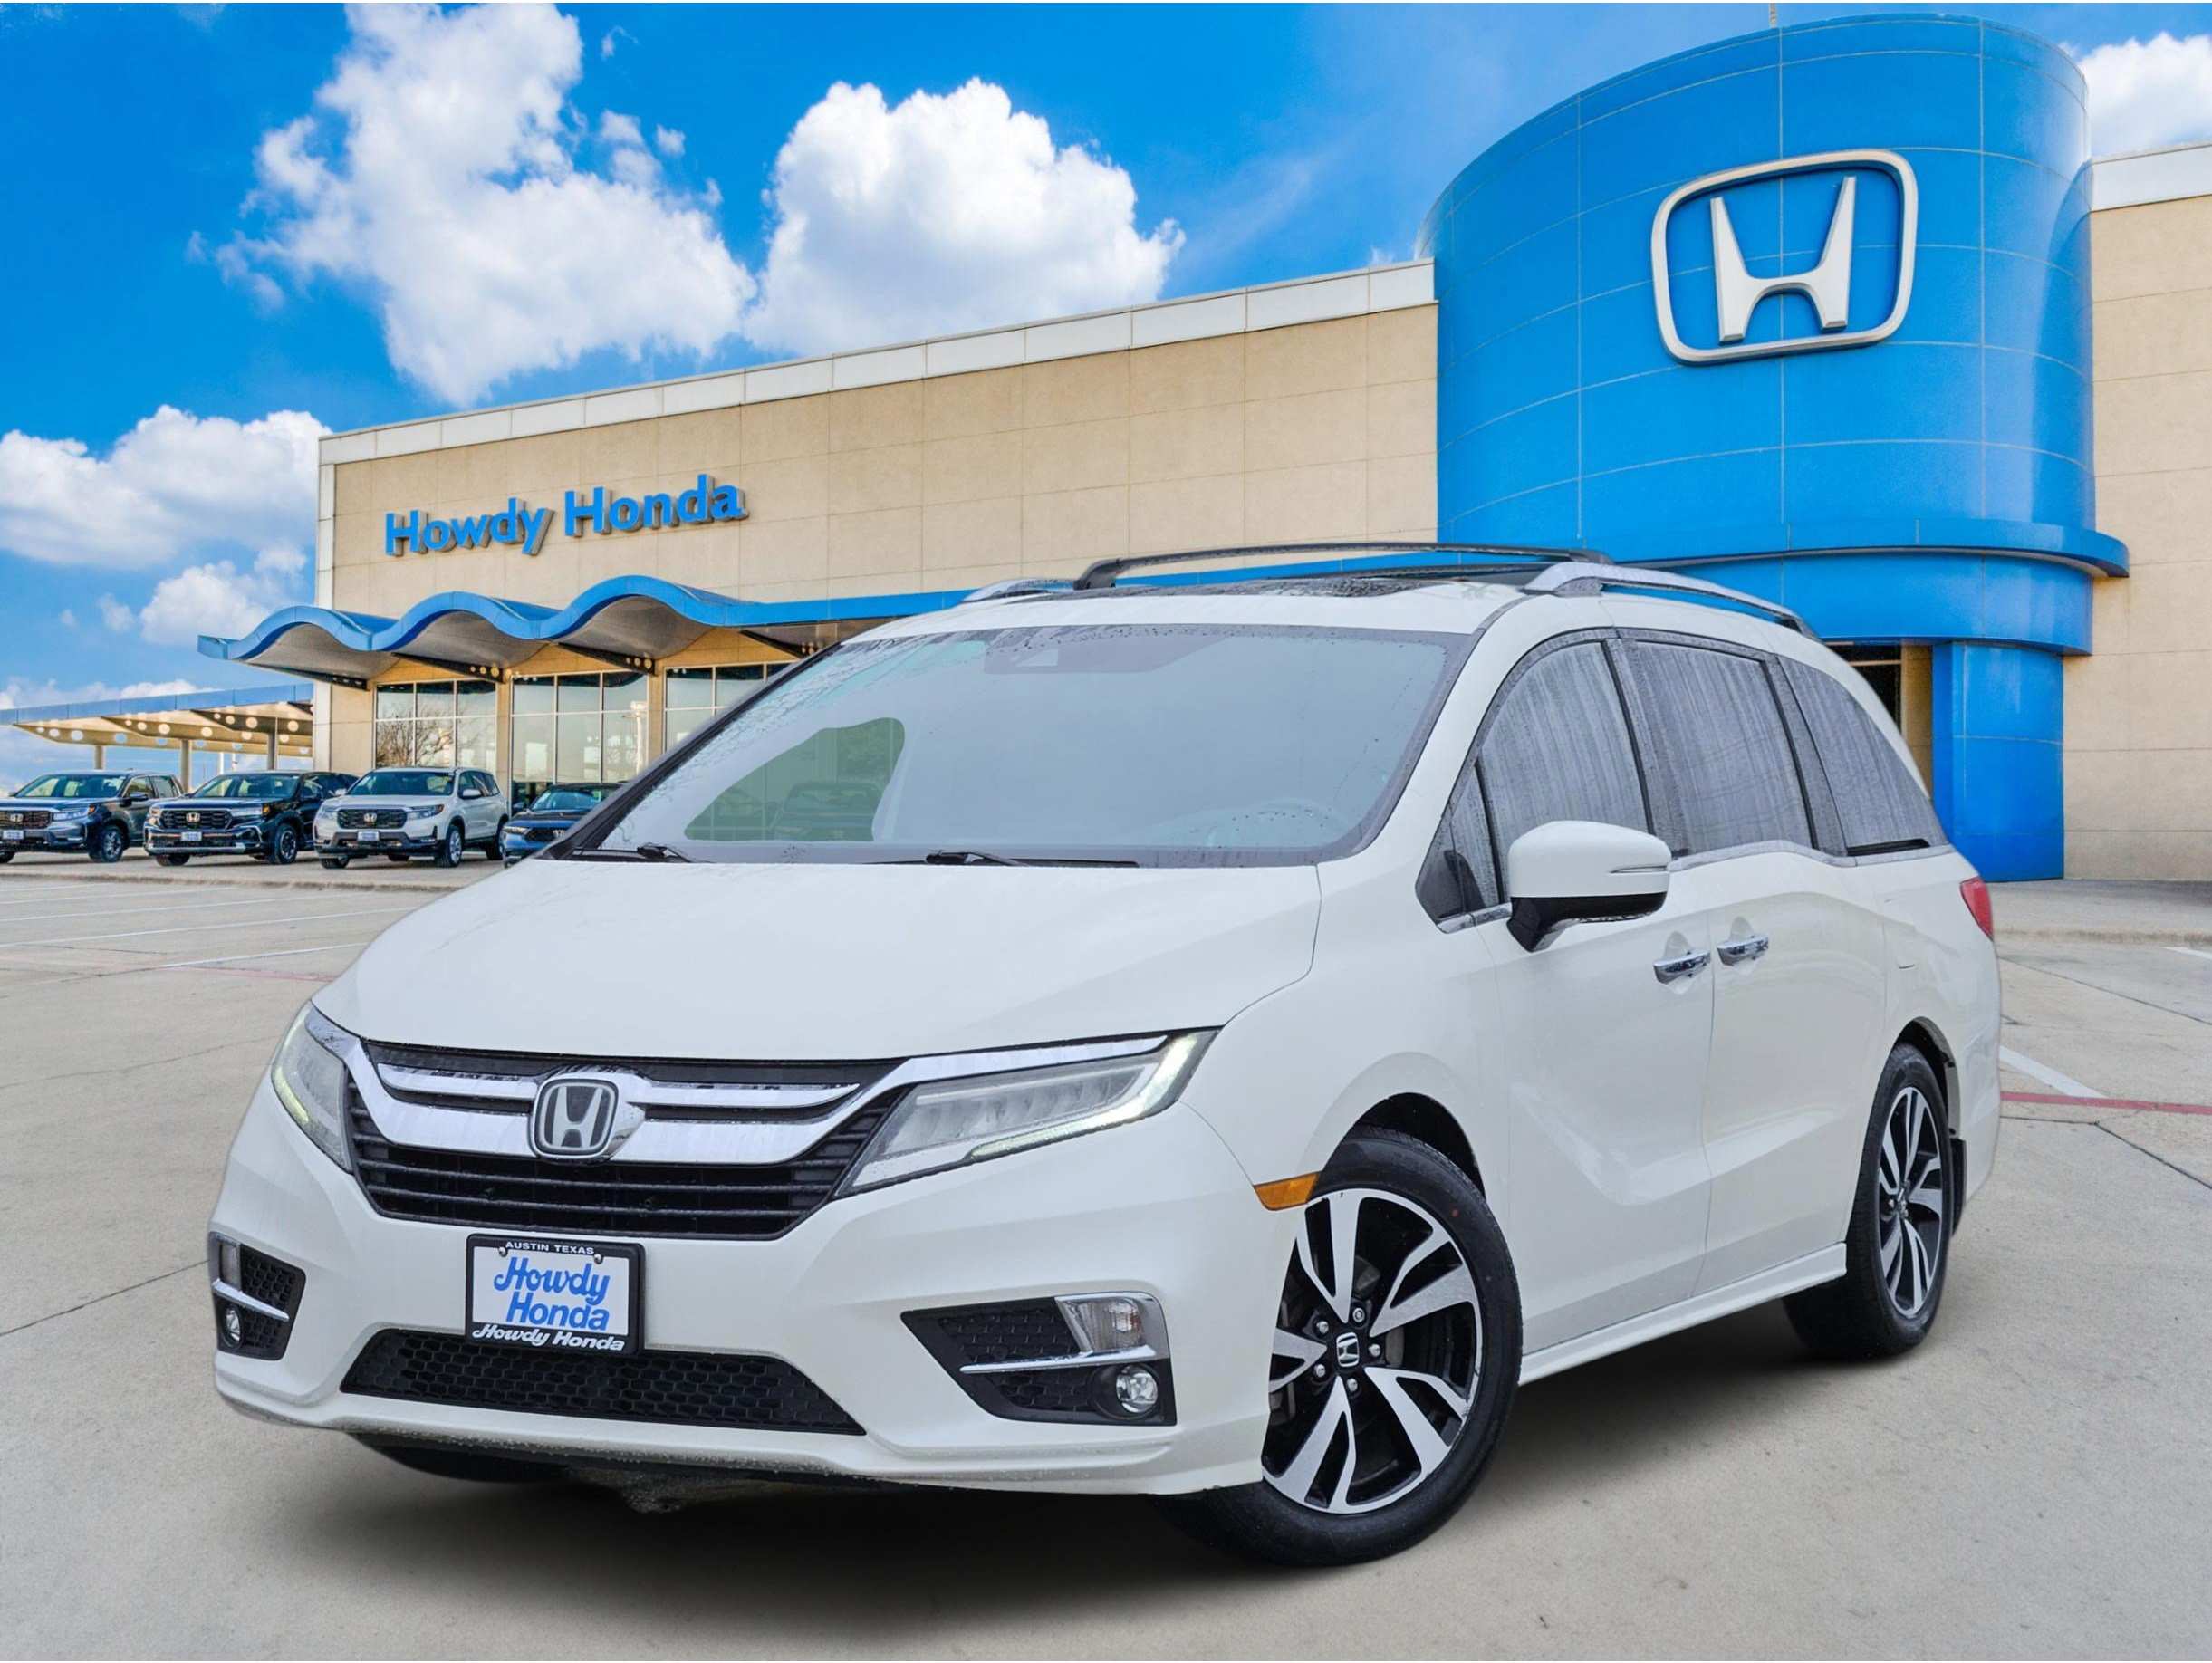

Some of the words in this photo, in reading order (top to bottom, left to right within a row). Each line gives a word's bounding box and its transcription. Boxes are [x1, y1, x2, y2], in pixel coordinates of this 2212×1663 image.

[385, 496, 554, 556] Howdy
[564, 474, 749, 538] Honda
[505, 1241, 549, 1252] AUSTIN
[553, 1245, 595, 1255] TEXAS
[493, 1256, 611, 1305] Howdy
[505, 1291, 610, 1331] Honda
[472, 1323, 551, 1346] Howdy
[552, 1331, 626, 1351] Honda
